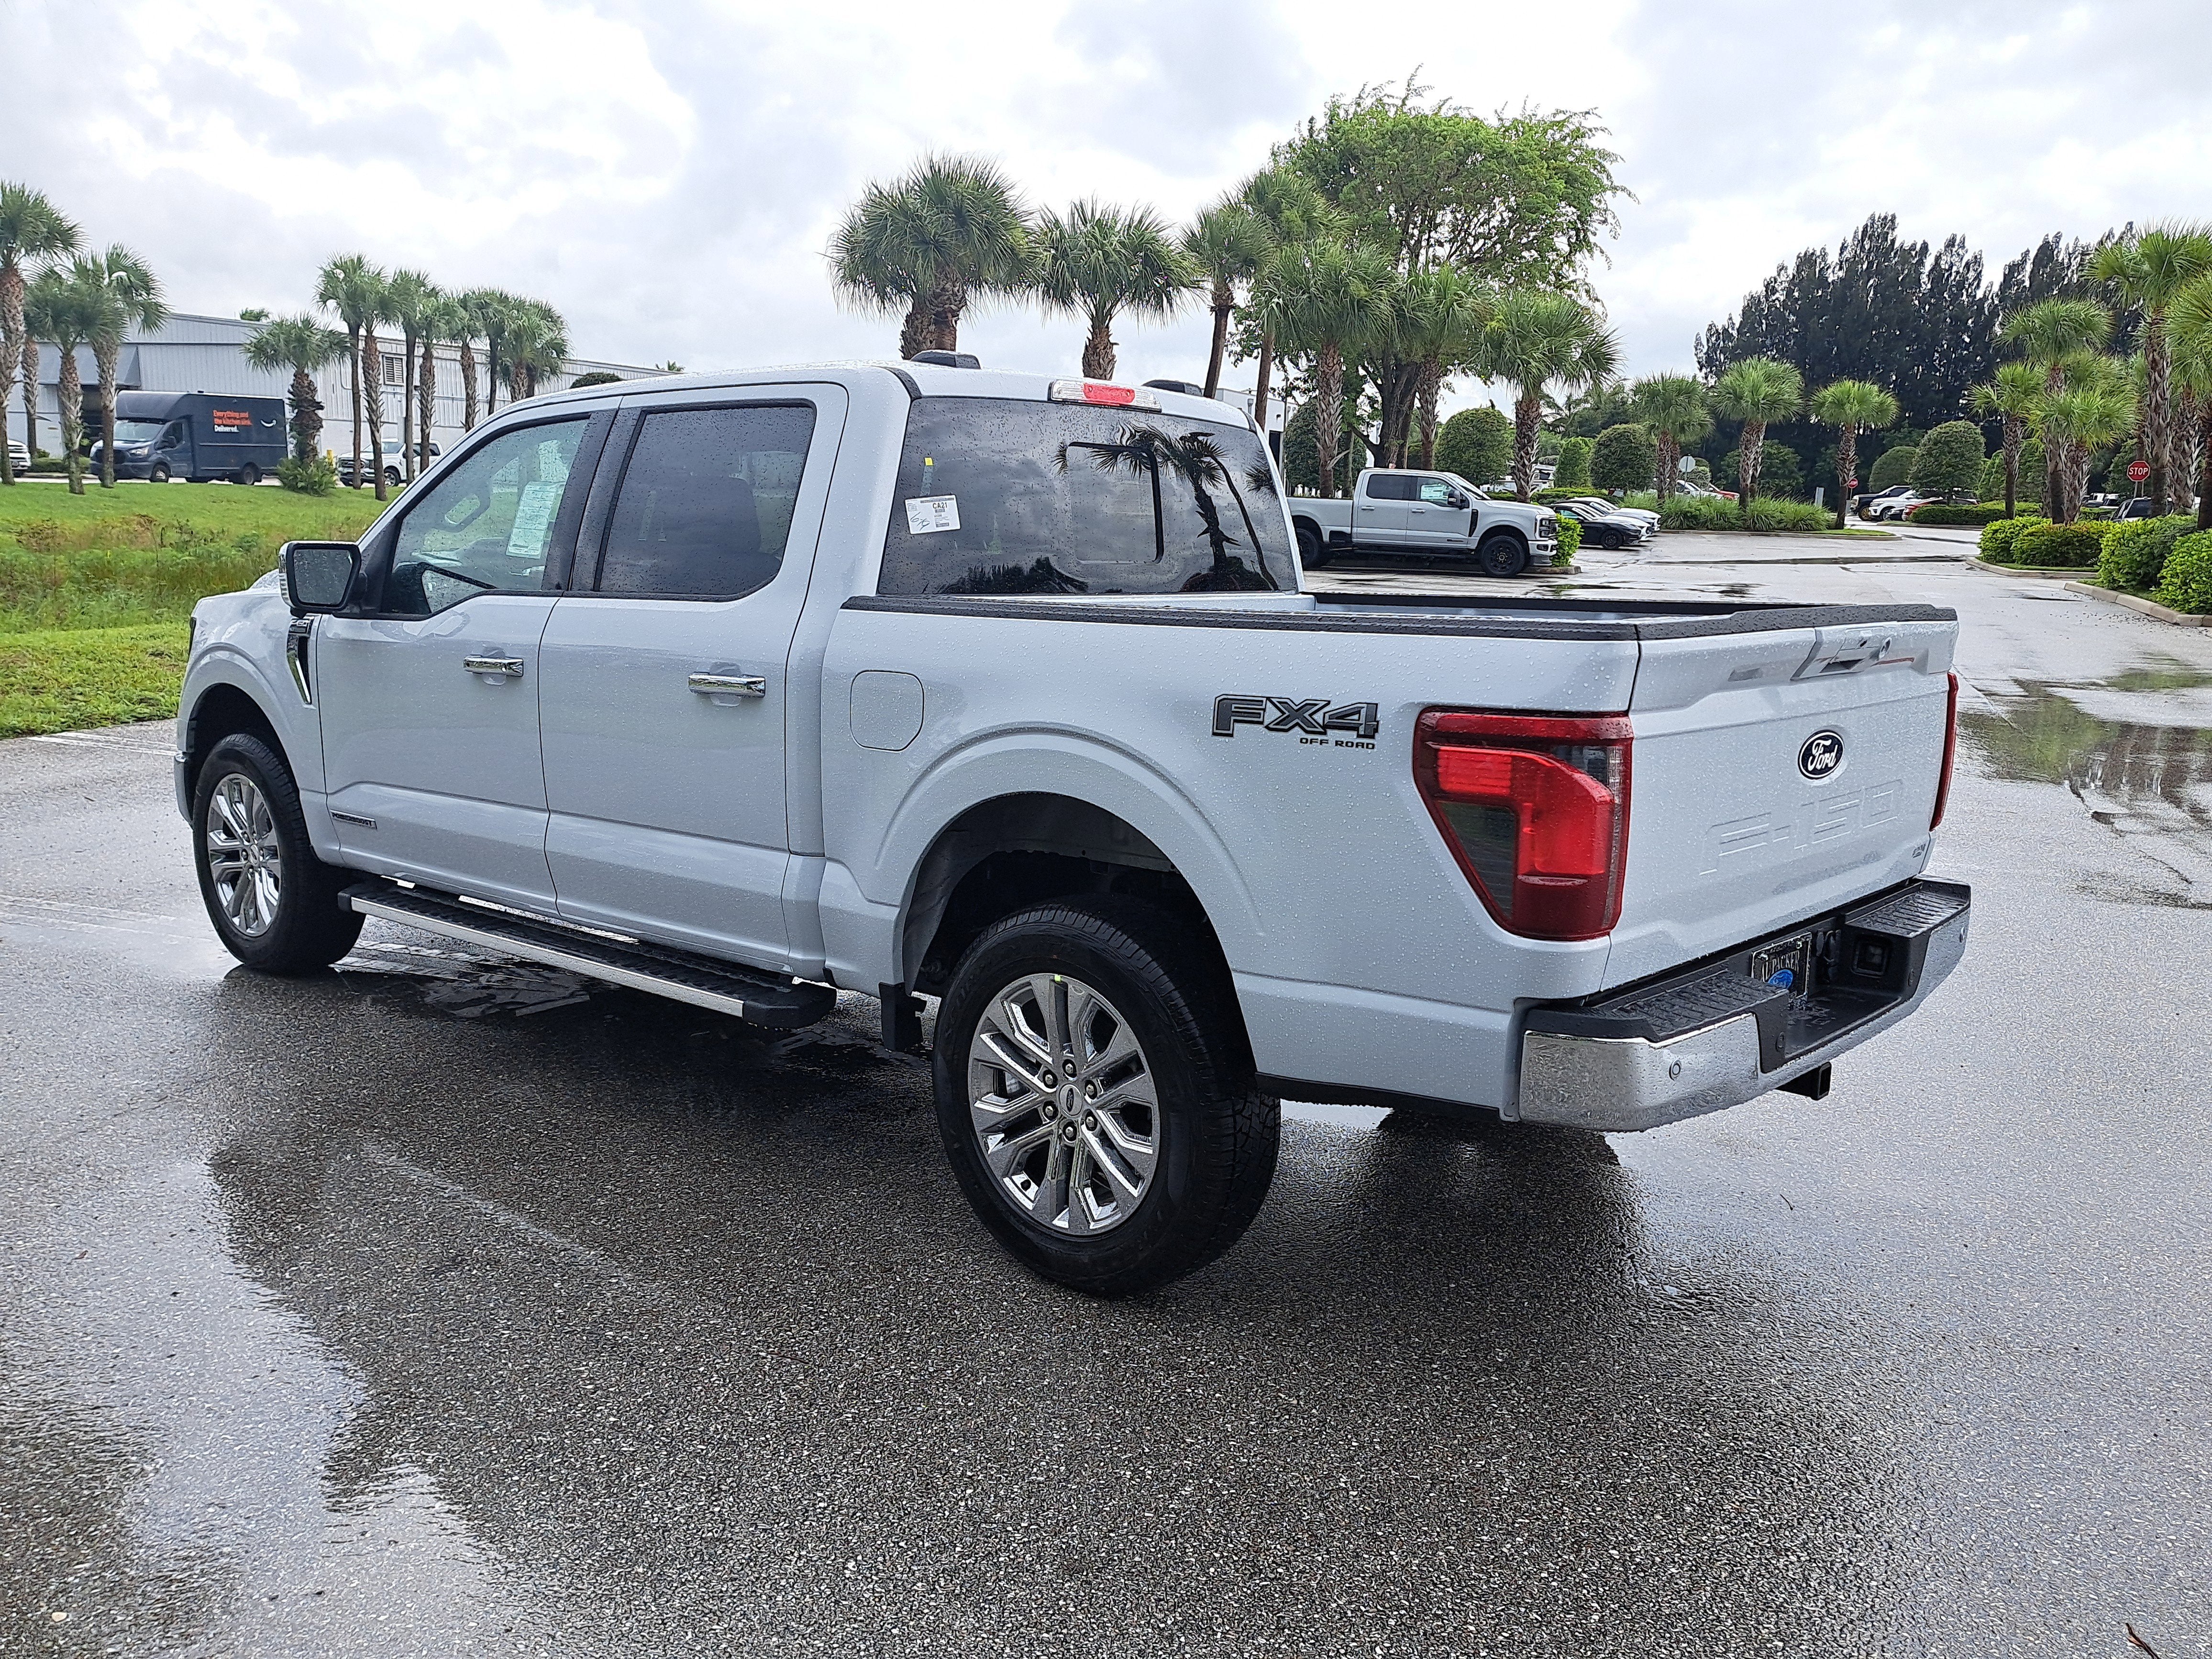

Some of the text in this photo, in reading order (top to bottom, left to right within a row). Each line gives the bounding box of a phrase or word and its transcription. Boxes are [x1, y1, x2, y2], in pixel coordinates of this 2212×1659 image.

[1211, 694, 1379, 739] FX4
[1335, 740, 1376, 750] ROAD
[1808, 739, 1838, 771] Ford
[1699, 779, 1903, 875] F-150
